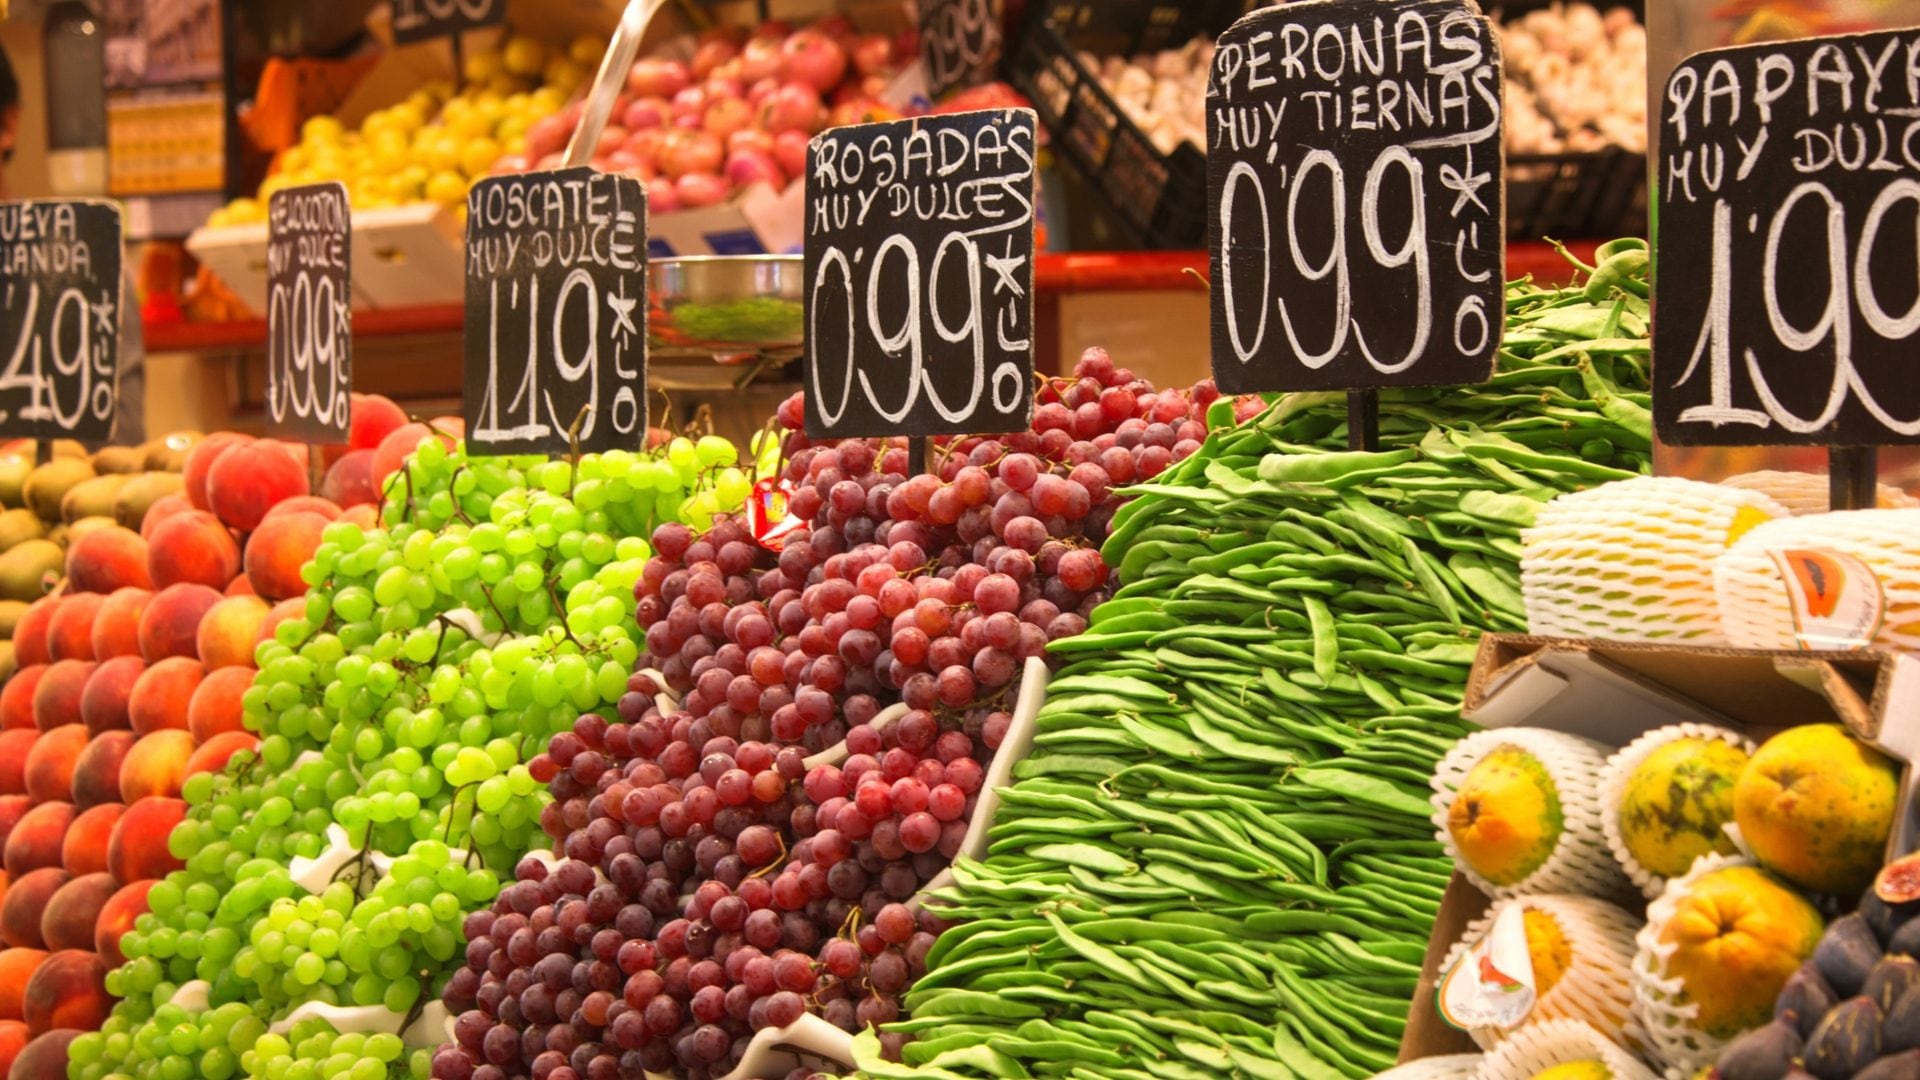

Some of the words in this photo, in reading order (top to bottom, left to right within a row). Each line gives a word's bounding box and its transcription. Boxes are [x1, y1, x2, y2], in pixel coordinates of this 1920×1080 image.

[1216, 10, 1484, 101] PERONAS
[814, 125, 1033, 188] ROSADAS
[1214, 97, 1287, 164] MUY
[1667, 126, 1769, 203] MUY
[468, 233, 521, 278] MUY
[531, 222, 642, 272] DULCE
[812, 186, 879, 236] MUY
[888, 177, 1032, 237] DULCES
[1219, 144, 1432, 374] 0'99
[1439, 143, 1492, 357] KILO
[0, 280, 91, 429] '49
[269, 271, 336, 425] 0'99
[472, 268, 599, 444] 1'19
[607, 273, 638, 434] KILO
[810, 230, 985, 427] 0'99
[985, 234, 1031, 414] KILO
